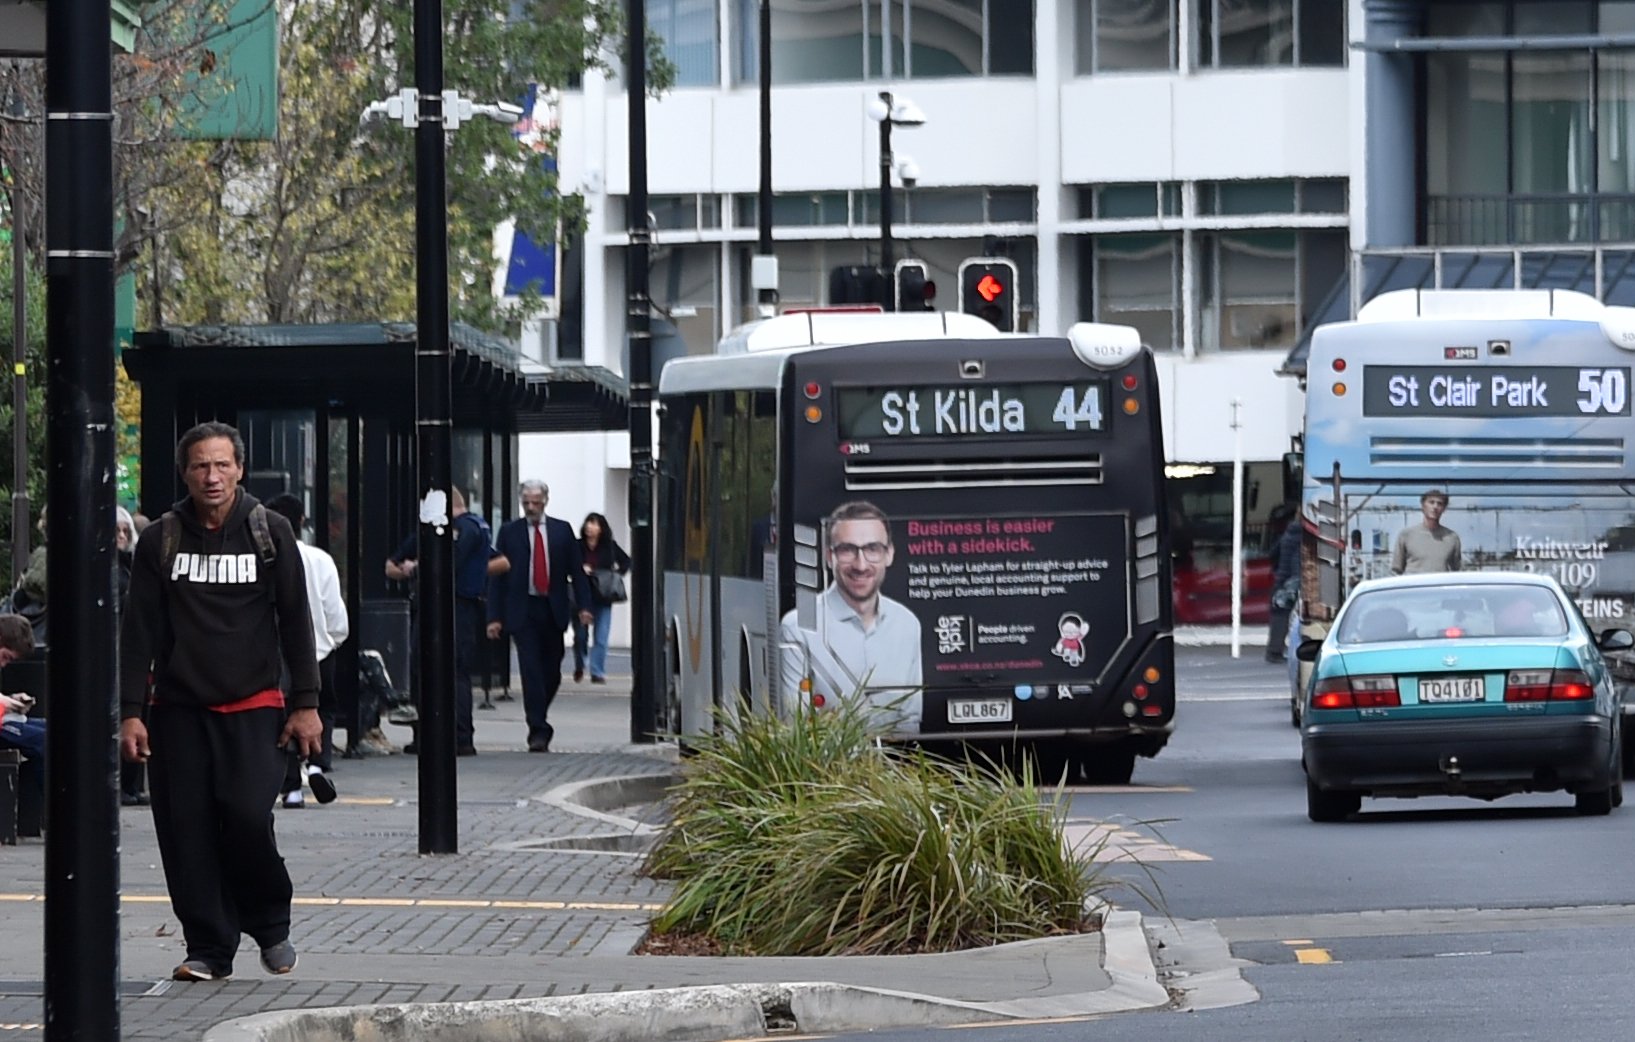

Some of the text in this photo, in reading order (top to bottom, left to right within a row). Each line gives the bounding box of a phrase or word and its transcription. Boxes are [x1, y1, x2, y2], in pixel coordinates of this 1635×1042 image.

[1388, 369, 1626, 413] St Clair Park 50
[881, 387, 1102, 435] St Kilda 44
[908, 519, 1054, 536] Business is easier
[908, 537, 1035, 555] with a sidekick.
[1515, 537, 1608, 559] Knitwear
[171, 553, 256, 583] PUMA
[909, 559, 1108, 575] Talk to Tyler Lapham for straight-up advice
[909, 572, 1100, 588] and genuine, local accounting support to
[909, 585, 1067, 600] help your Dunedin business grow.
[978, 624, 1035, 635] People driven
[978, 634, 1028, 644] accounting.
[1421, 679, 1482, 699] TQ4101
[953, 703, 1006, 718] LQL867
